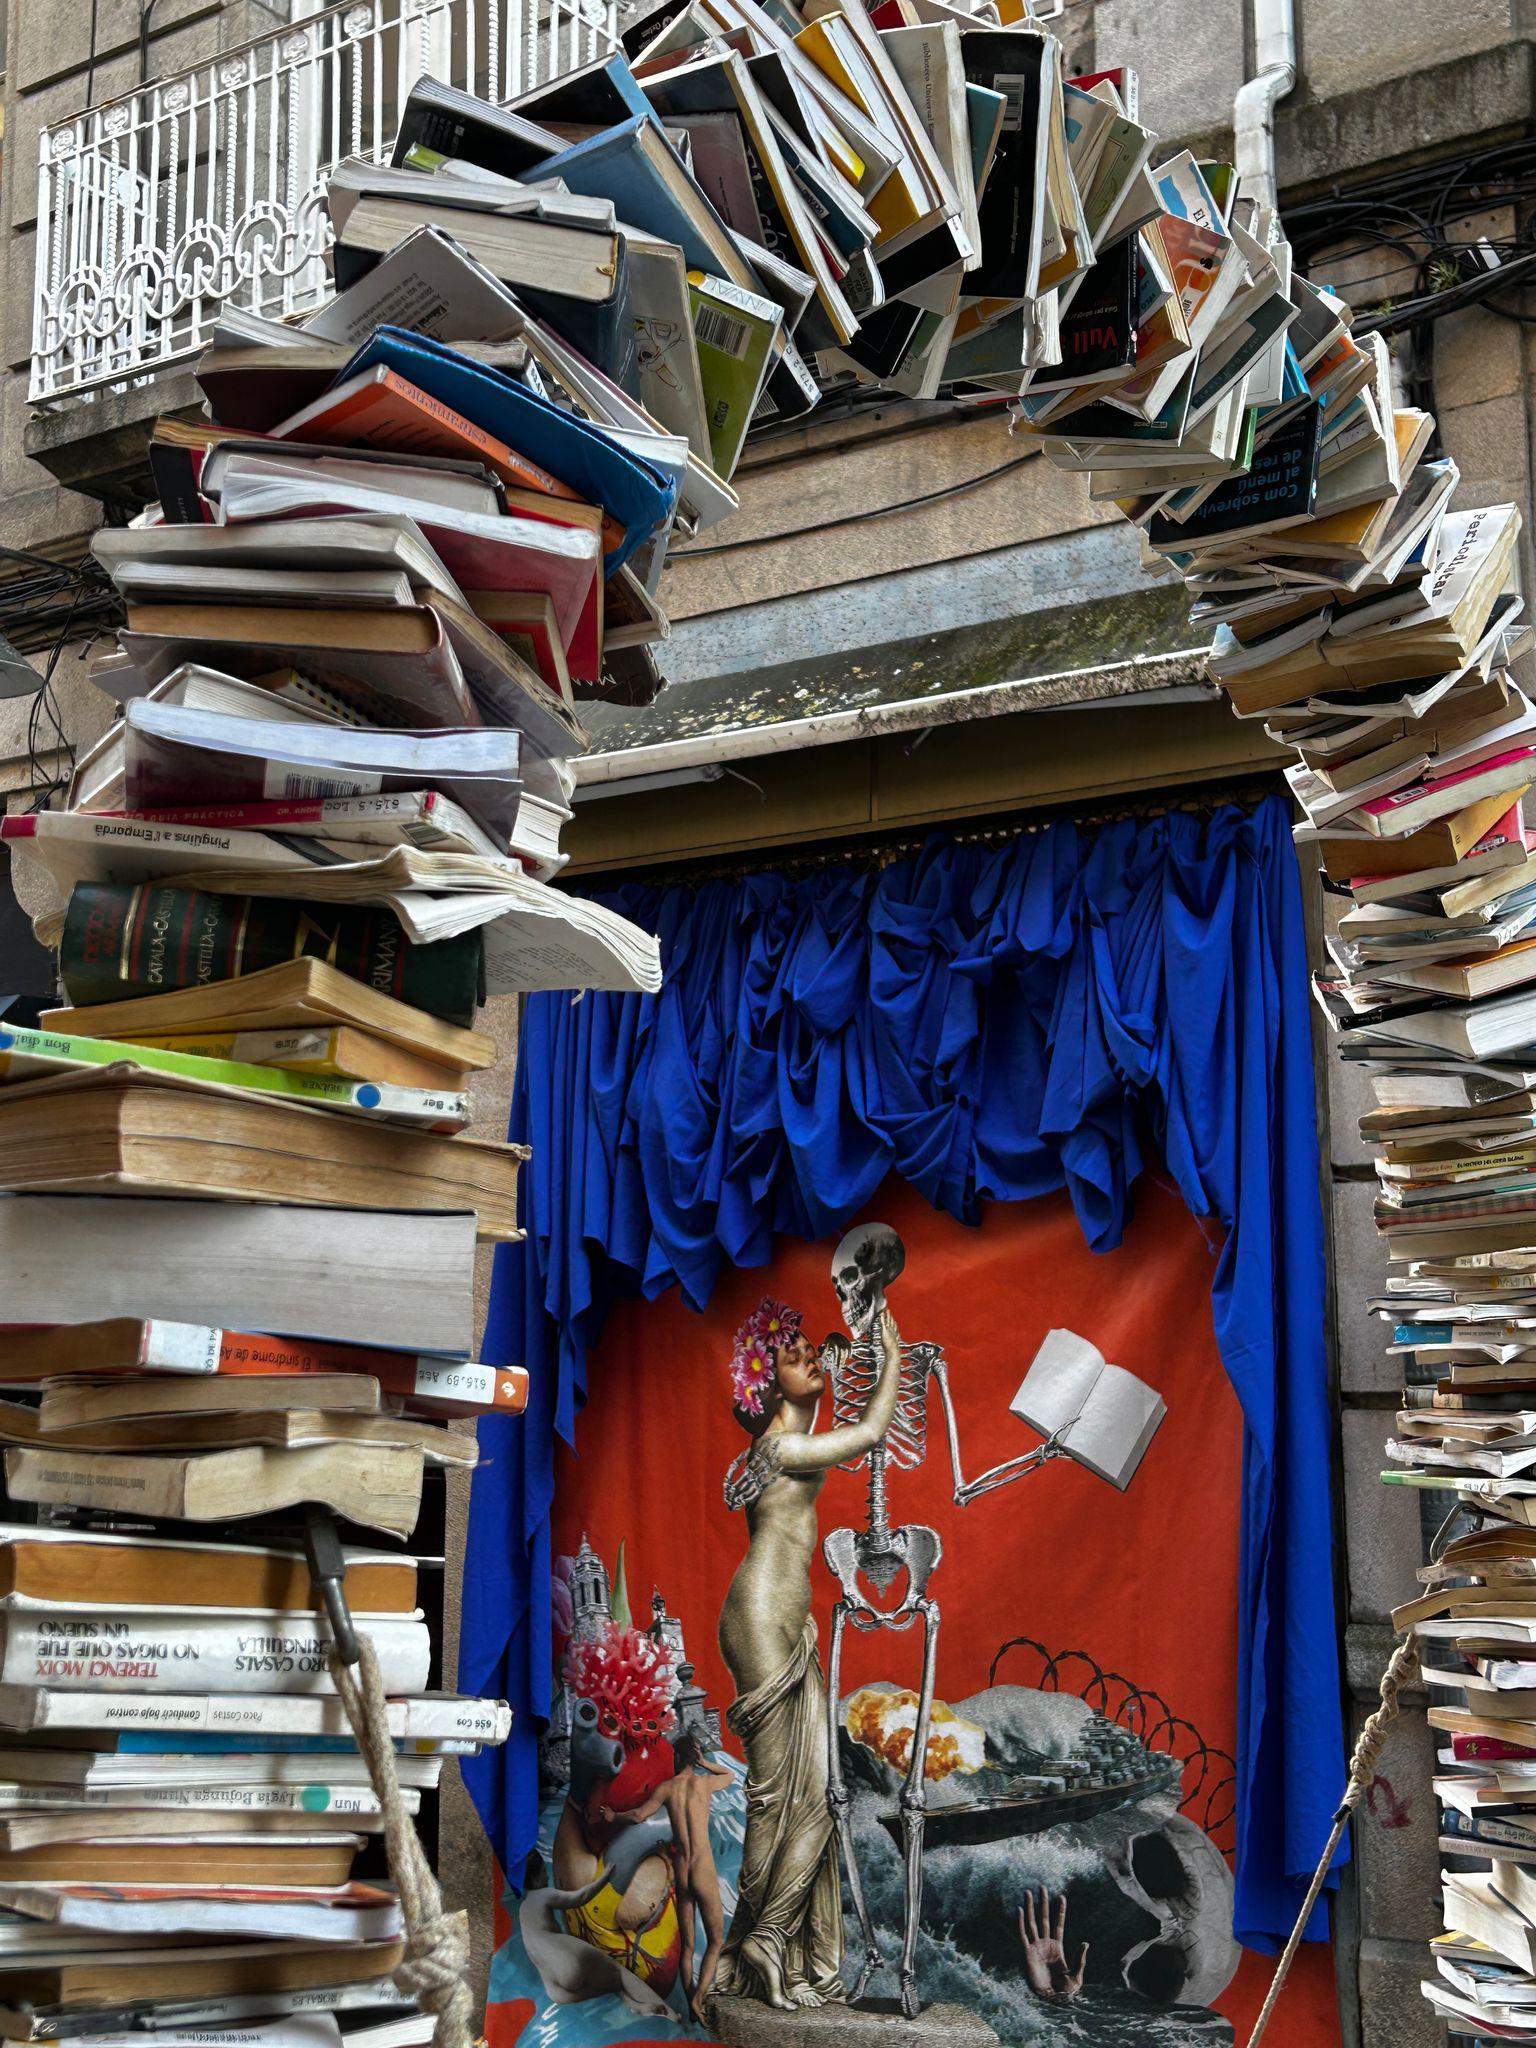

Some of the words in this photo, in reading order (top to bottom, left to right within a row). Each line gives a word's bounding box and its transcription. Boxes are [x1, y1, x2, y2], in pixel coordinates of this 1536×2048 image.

[1073, 326, 1118, 354] Vull
[1286, 464, 1301, 482] al
[1264, 483, 1298, 501] Com
[162, 832, 173, 841] a
[175, 832, 231, 850] Pingüins
[44, 1039, 71, 1054] Bon
[236, 1349, 249, 1363] de
[104, 1622, 129, 1639] UN
[37, 1639, 70, 1658] FUE
[74, 1640, 112, 1658] QUE
[117, 1642, 168, 1659] DIGAS
[173, 1643, 200, 1660] NO
[36, 1659, 85, 1676] MOIX
[89, 1660, 158, 1678] TERENCI
[235, 1654, 294, 1672] CASALS
[106, 1707, 140, 1720] control
[161, 1707, 201, 1722] Conducir
